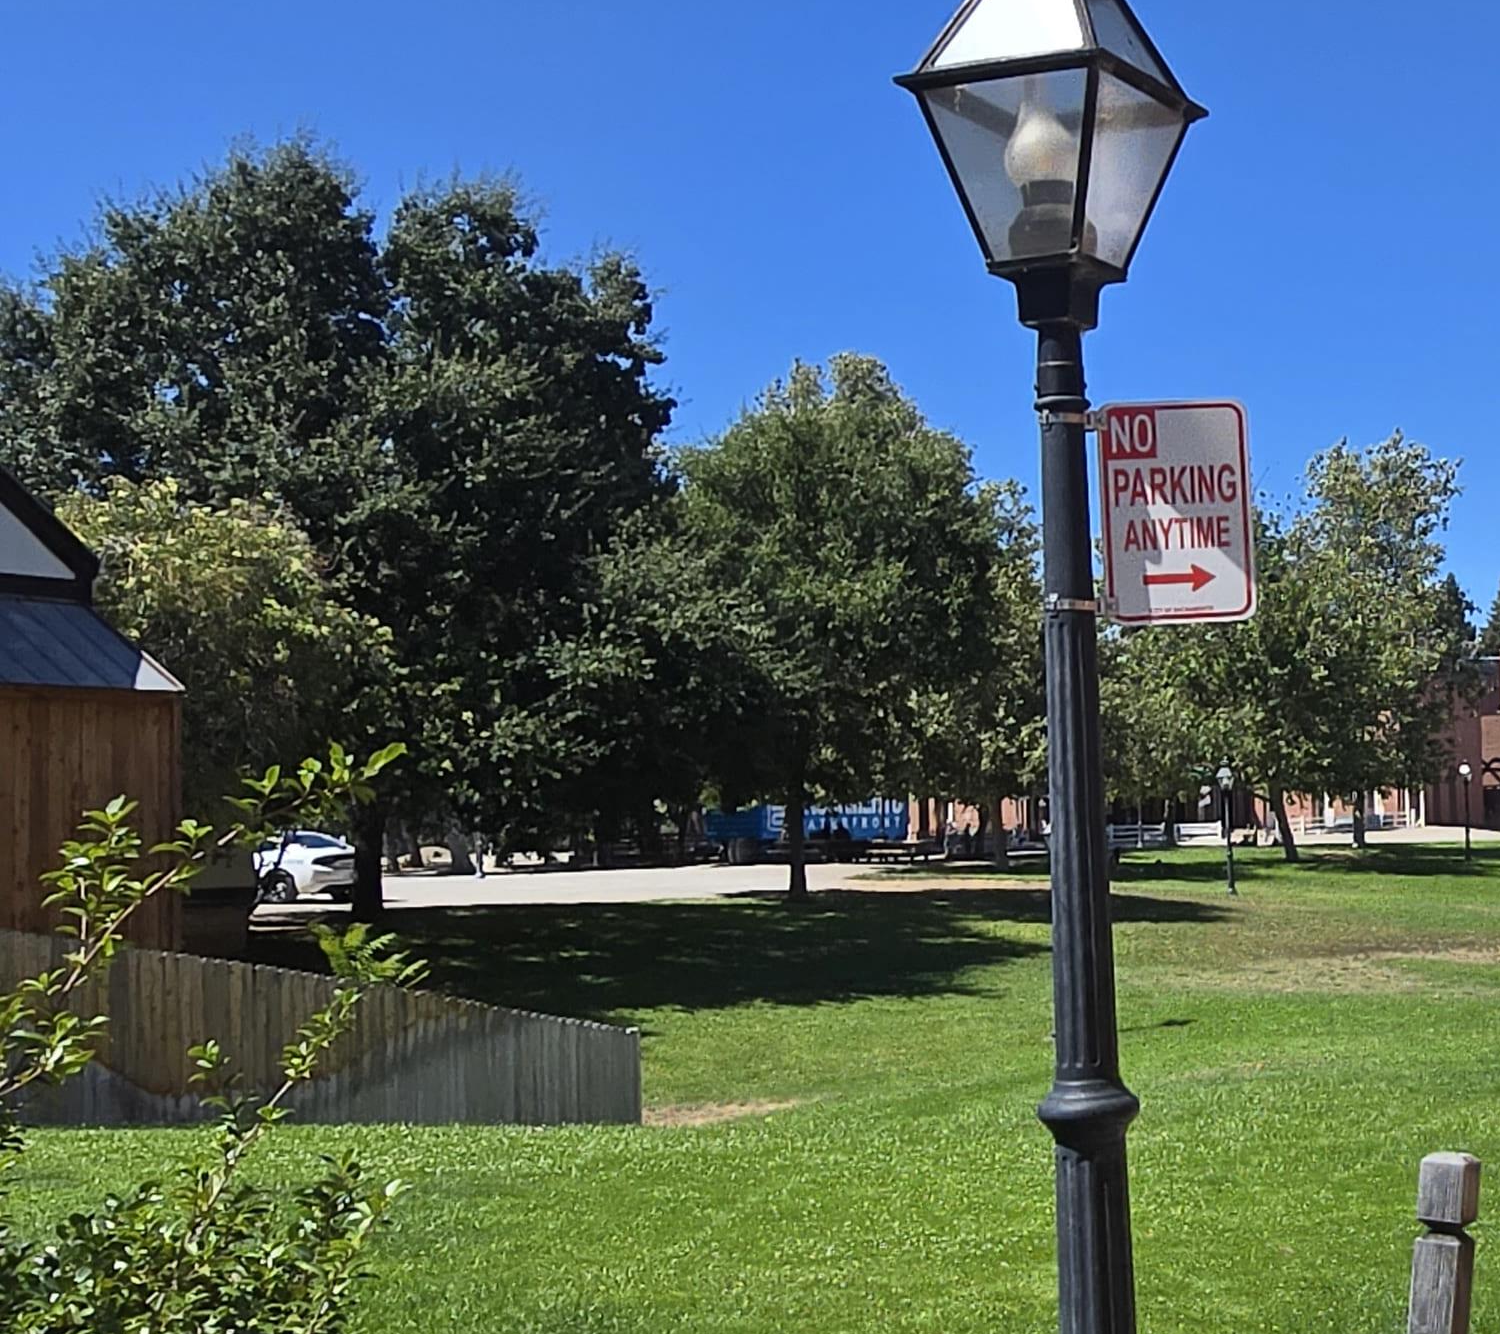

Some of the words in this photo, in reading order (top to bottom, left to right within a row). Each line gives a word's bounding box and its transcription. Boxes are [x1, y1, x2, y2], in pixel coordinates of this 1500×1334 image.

[1109, 414, 1153, 454] NO
[1113, 463, 1237, 507] PARKING
[1124, 516, 1231, 553] ANYTIME
